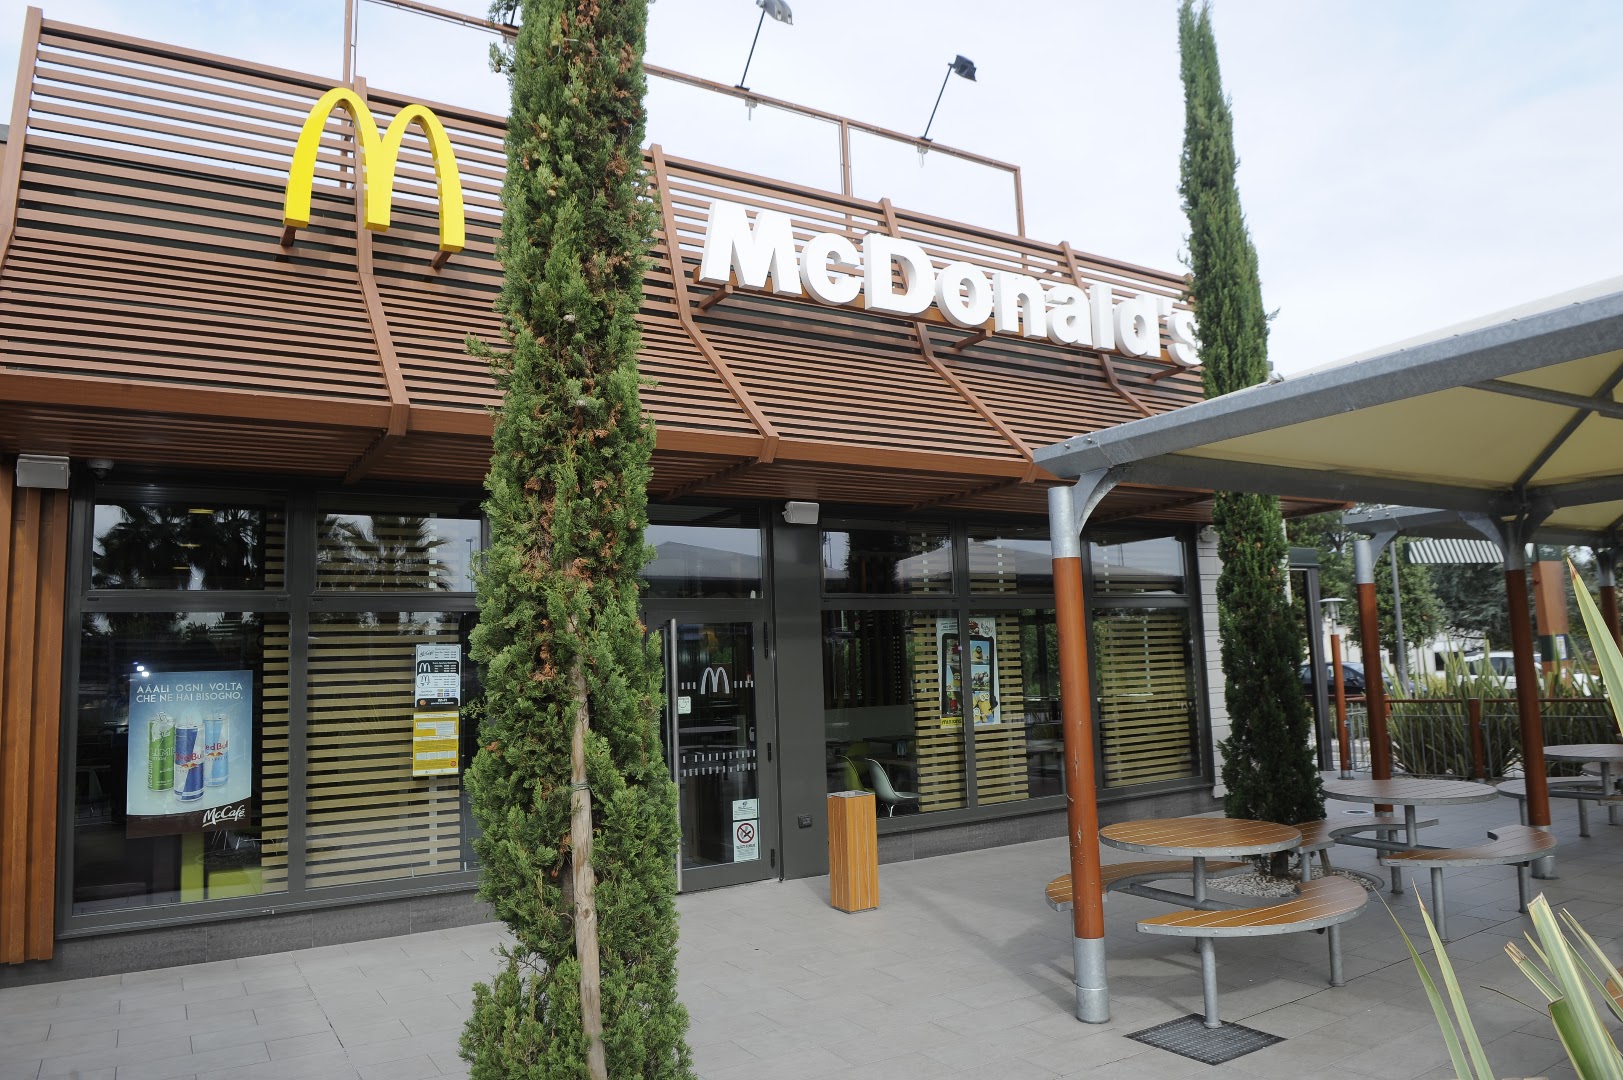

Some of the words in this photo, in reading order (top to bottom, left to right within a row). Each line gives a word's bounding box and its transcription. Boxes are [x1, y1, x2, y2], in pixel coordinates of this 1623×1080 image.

[699, 199, 1204, 366] McDonald's
[175, 683, 203, 692] OGNI
[209, 682, 243, 691] VOLTA
[136, 694, 157, 703] CHE
[159, 693, 173, 702] NE
[176, 693, 193, 701] HAI
[196, 691, 243, 701] BISOGNO.
[202, 804, 246, 827] McCafé
